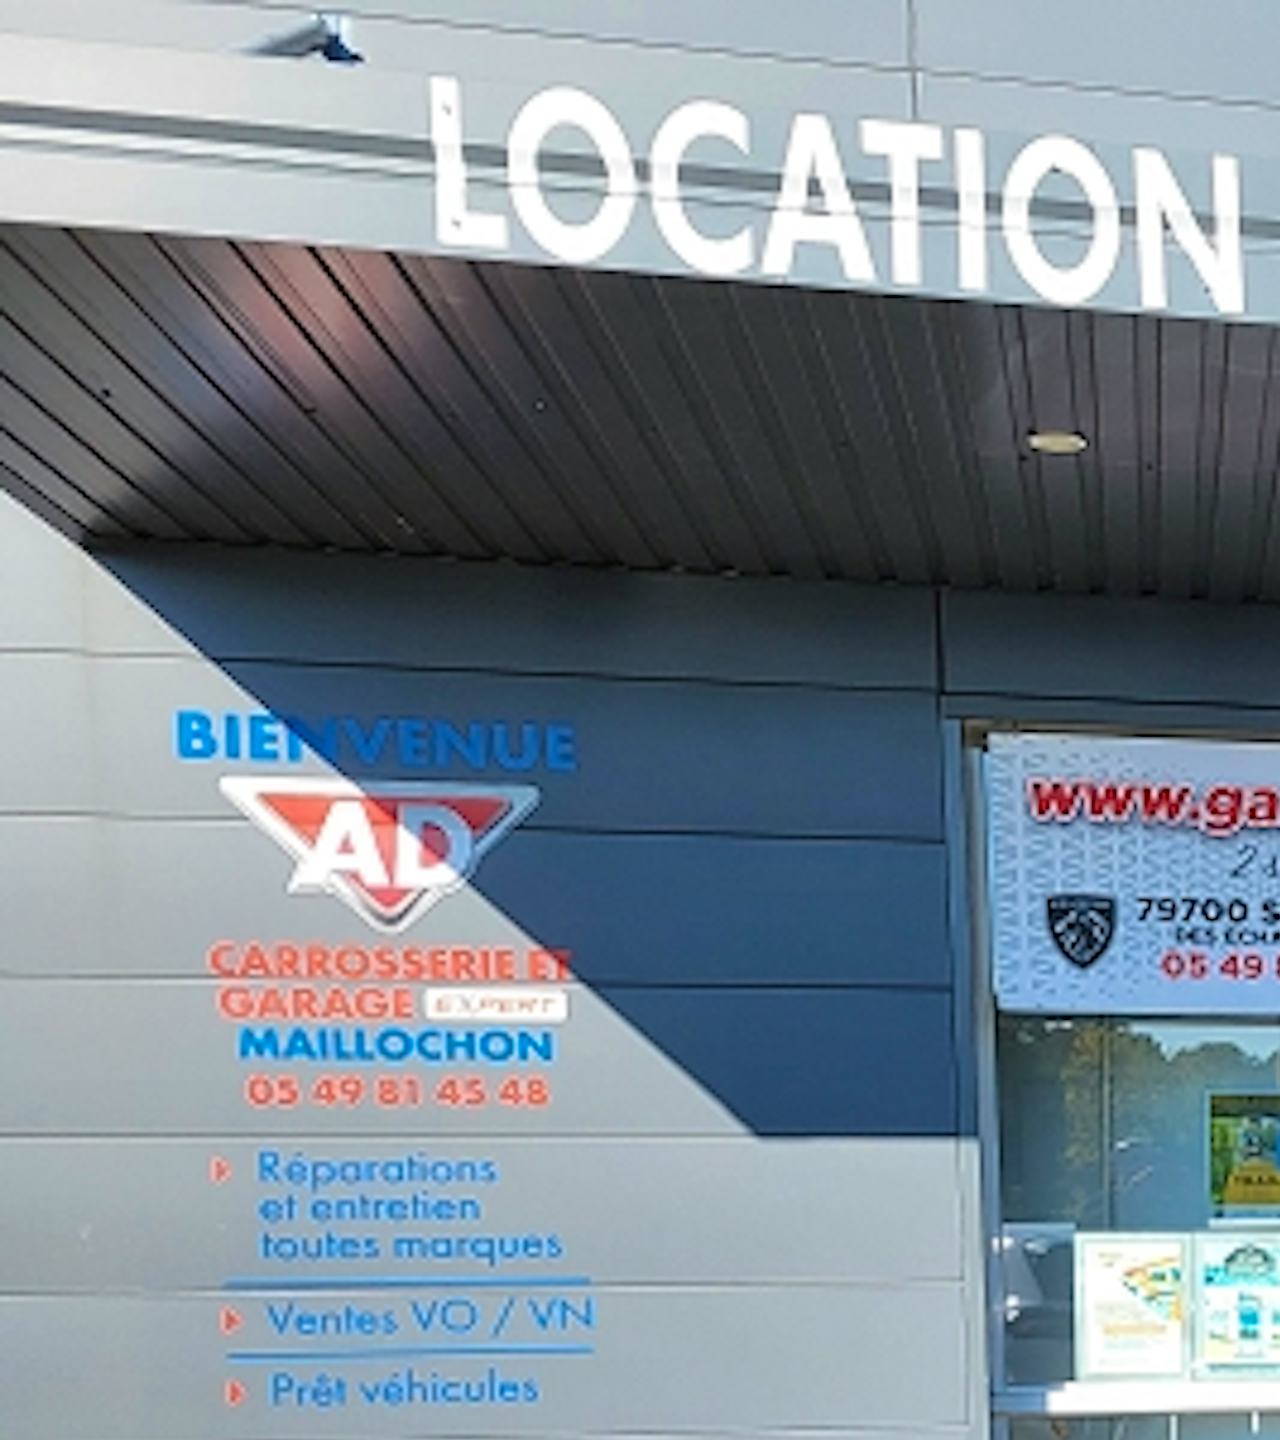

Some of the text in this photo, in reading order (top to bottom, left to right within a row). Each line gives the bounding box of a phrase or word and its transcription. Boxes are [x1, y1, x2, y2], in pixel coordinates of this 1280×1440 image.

[429, 75, 1244, 316] LOCATION
[175, 711, 578, 772] BIENVENUE
[288, 799, 475, 891] AD
[1230, 845, 1258, 878] 2
[1137, 898, 1248, 924] 79700
[208, 945, 571, 982] CARROSSERIE ET
[1161, 953, 1207, 980] 05
[1219, 954, 1263, 981] 49
[220, 987, 415, 1020] GARAGE
[239, 1027, 554, 1062] MAILLOCHON
[248, 1075, 550, 1106] 05 49 81 45 48
[256, 1150, 499, 1192] Réparations
[259, 1190, 482, 1221] et entretien
[259, 1232, 564, 1266] toutes marques
[266, 1297, 597, 1337] Ventes VO / VN
[271, 1368, 541, 1407] Prêt véhicules
